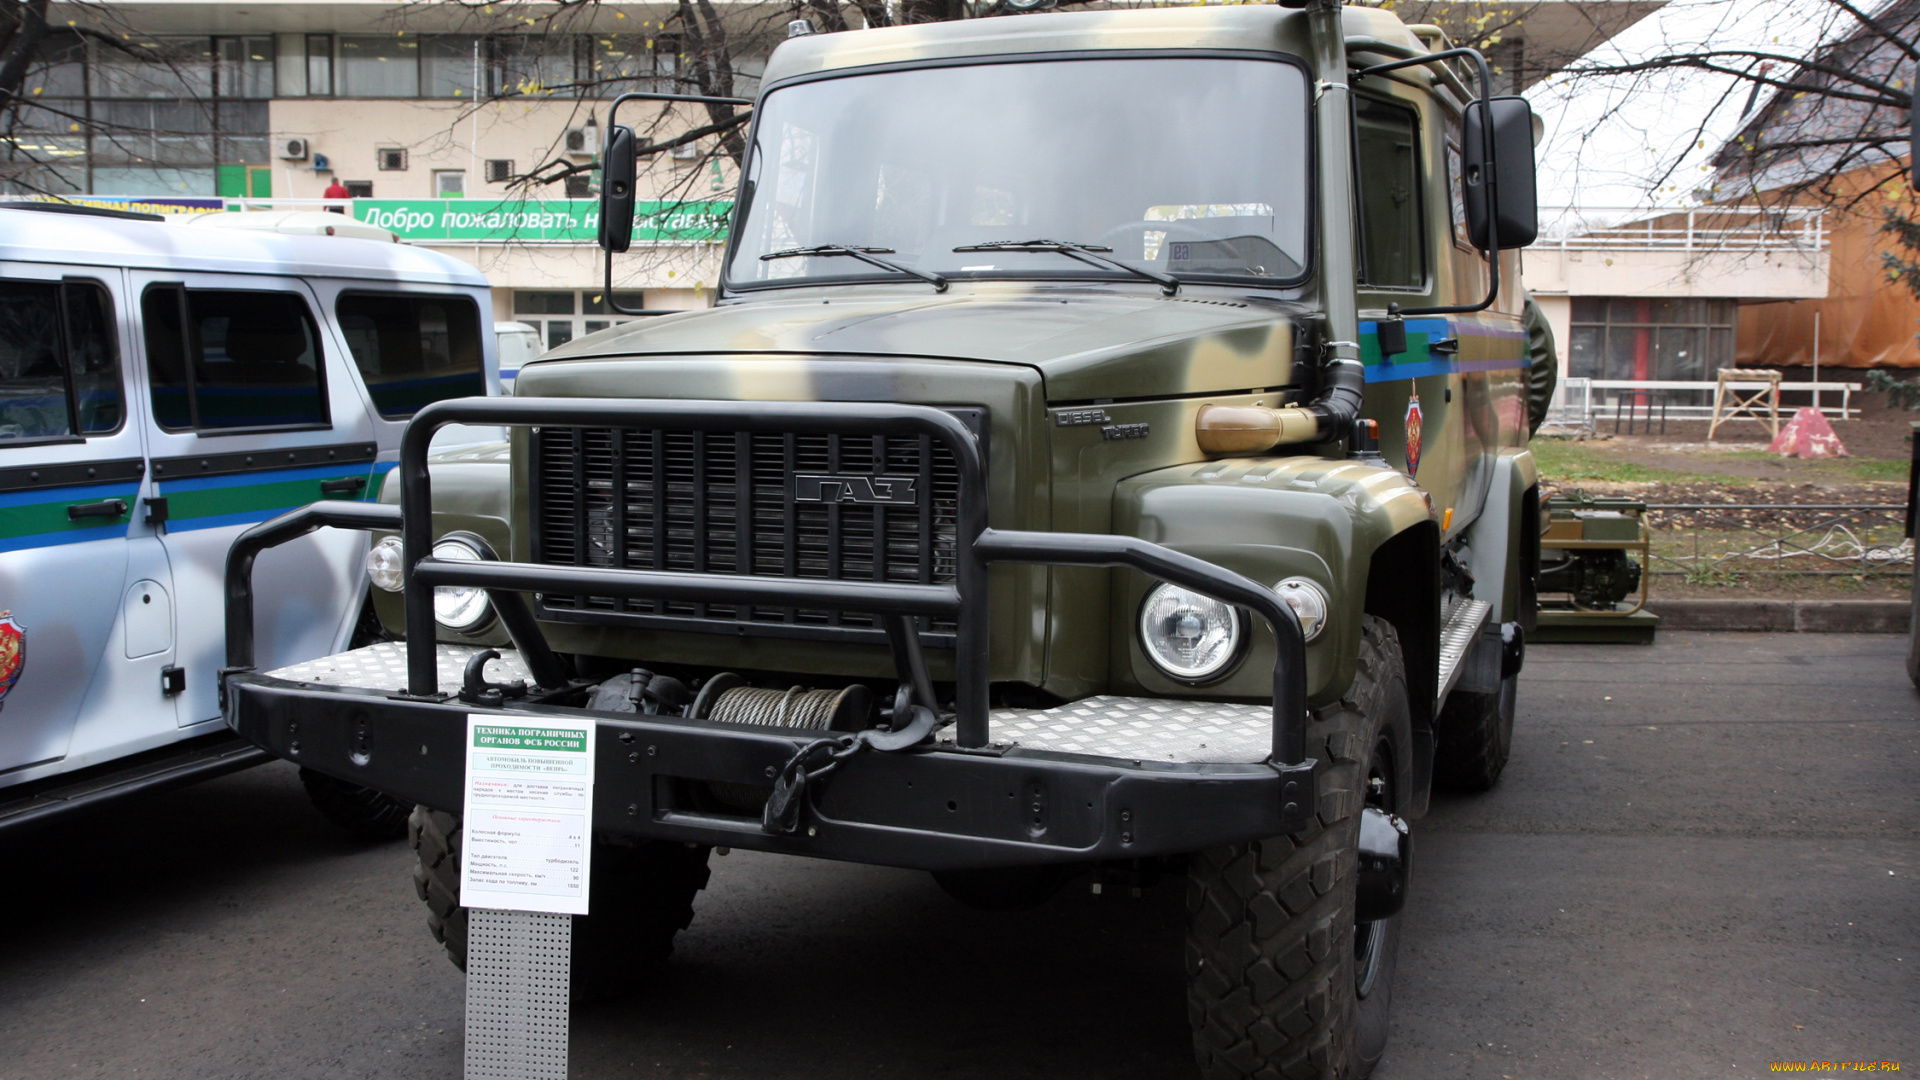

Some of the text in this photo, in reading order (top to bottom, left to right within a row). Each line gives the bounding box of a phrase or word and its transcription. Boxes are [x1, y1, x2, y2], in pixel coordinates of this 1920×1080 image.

[364, 207, 435, 232] Добро
[441, 211, 578, 229] пожаловать
[1056, 409, 1111, 427] DIESEL
[1101, 423, 1149, 440] TURBO
[796, 475, 916, 504] ГАЗ
[475, 726, 585, 739] ТЕХНИКА ПОГРАНИЧНЫХ
[480, 736, 580, 748] ОРГАНОВ ФСБ РОССИИ
[490, 763, 541, 771] ПРОХОДИМОСТИ
[528, 758, 574, 766] ПОВЫШЕННОЙ
